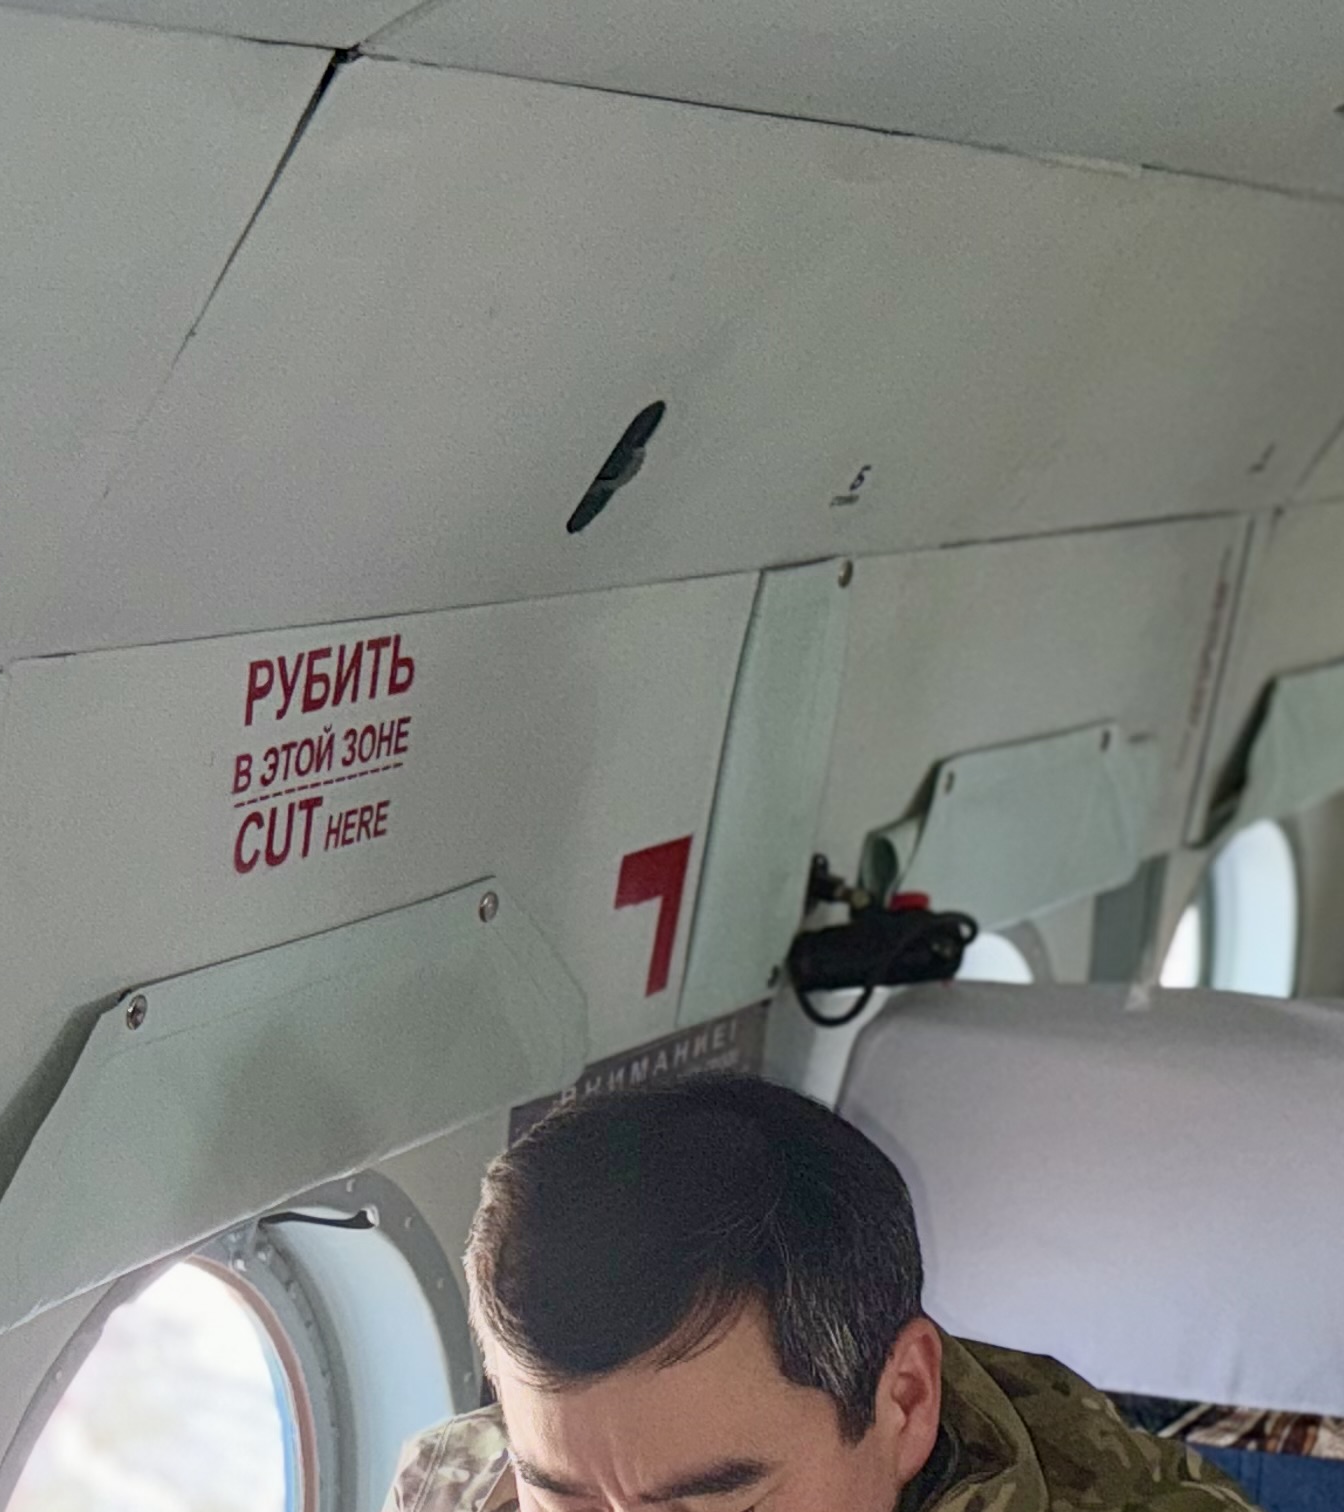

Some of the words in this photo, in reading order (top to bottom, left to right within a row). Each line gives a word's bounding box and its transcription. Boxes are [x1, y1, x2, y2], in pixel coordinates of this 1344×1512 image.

[244, 633, 416, 727] РУБИТЬ
[232, 753, 254, 795] В
[260, 723, 336, 788] ЭТОЙ
[341, 716, 412, 767] ЗОНЕ
[233, 795, 324, 875] CUT
[324, 800, 391, 852] HERE
